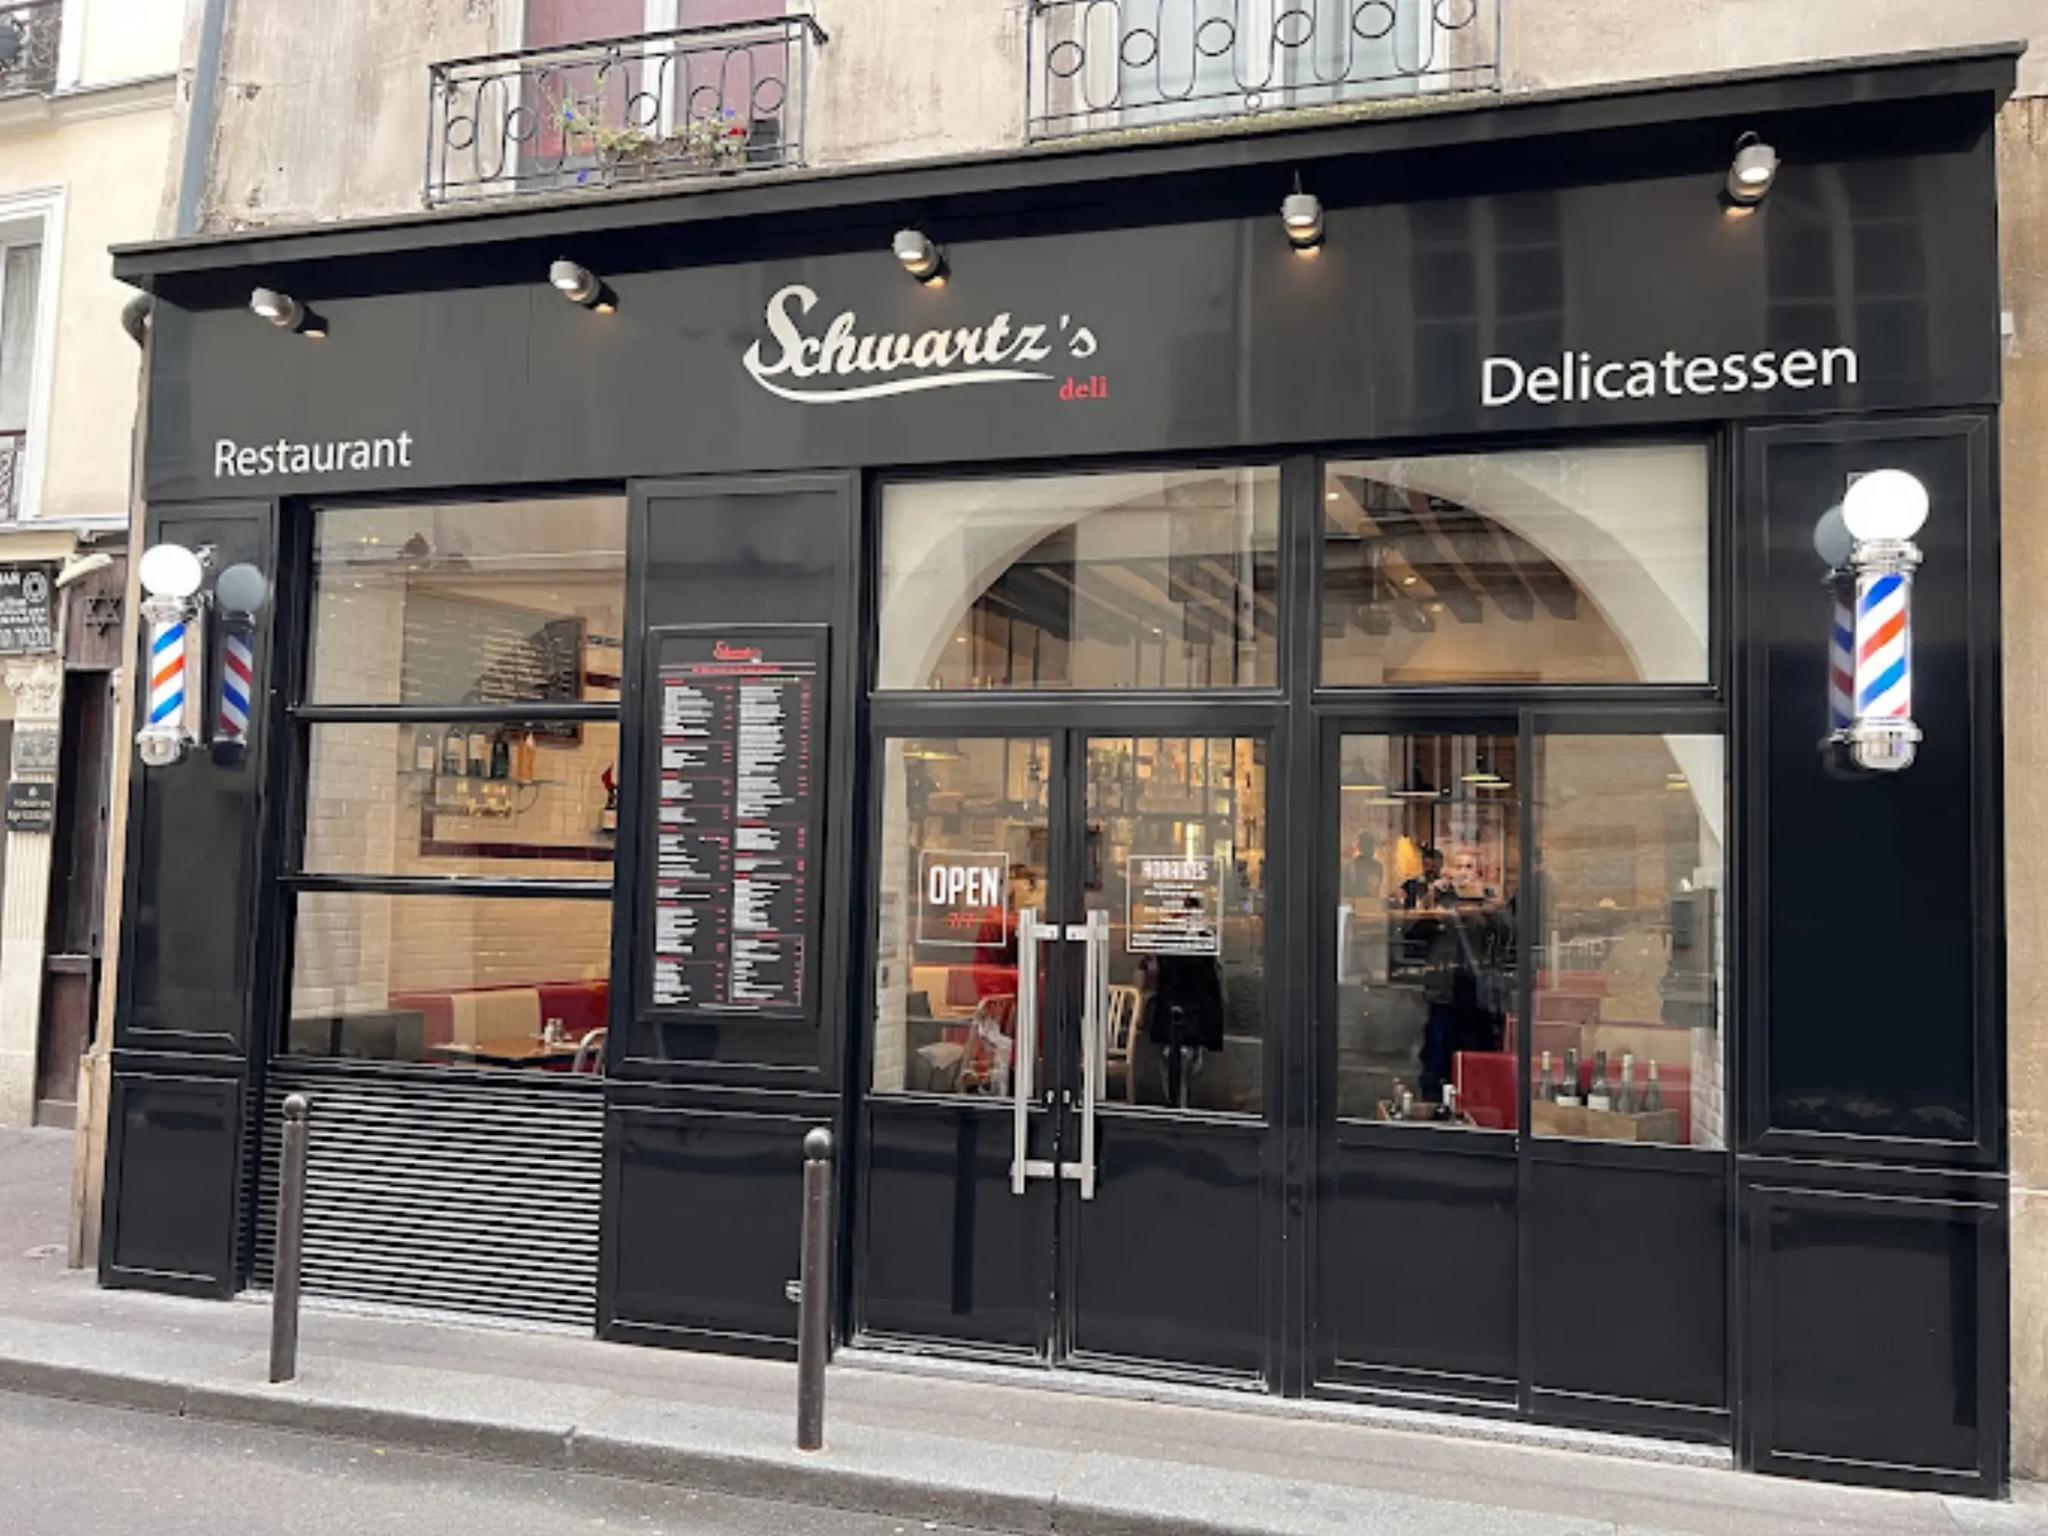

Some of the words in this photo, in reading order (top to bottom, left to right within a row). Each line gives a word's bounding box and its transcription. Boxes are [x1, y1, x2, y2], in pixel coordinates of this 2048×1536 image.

[743, 284, 1098, 379] Schwartz's
[1058, 376, 1108, 401] deli
[1481, 345, 1858, 407] Delicatessen
[214, 430, 413, 478] Restaurant
[929, 865, 999, 907] OPEN
